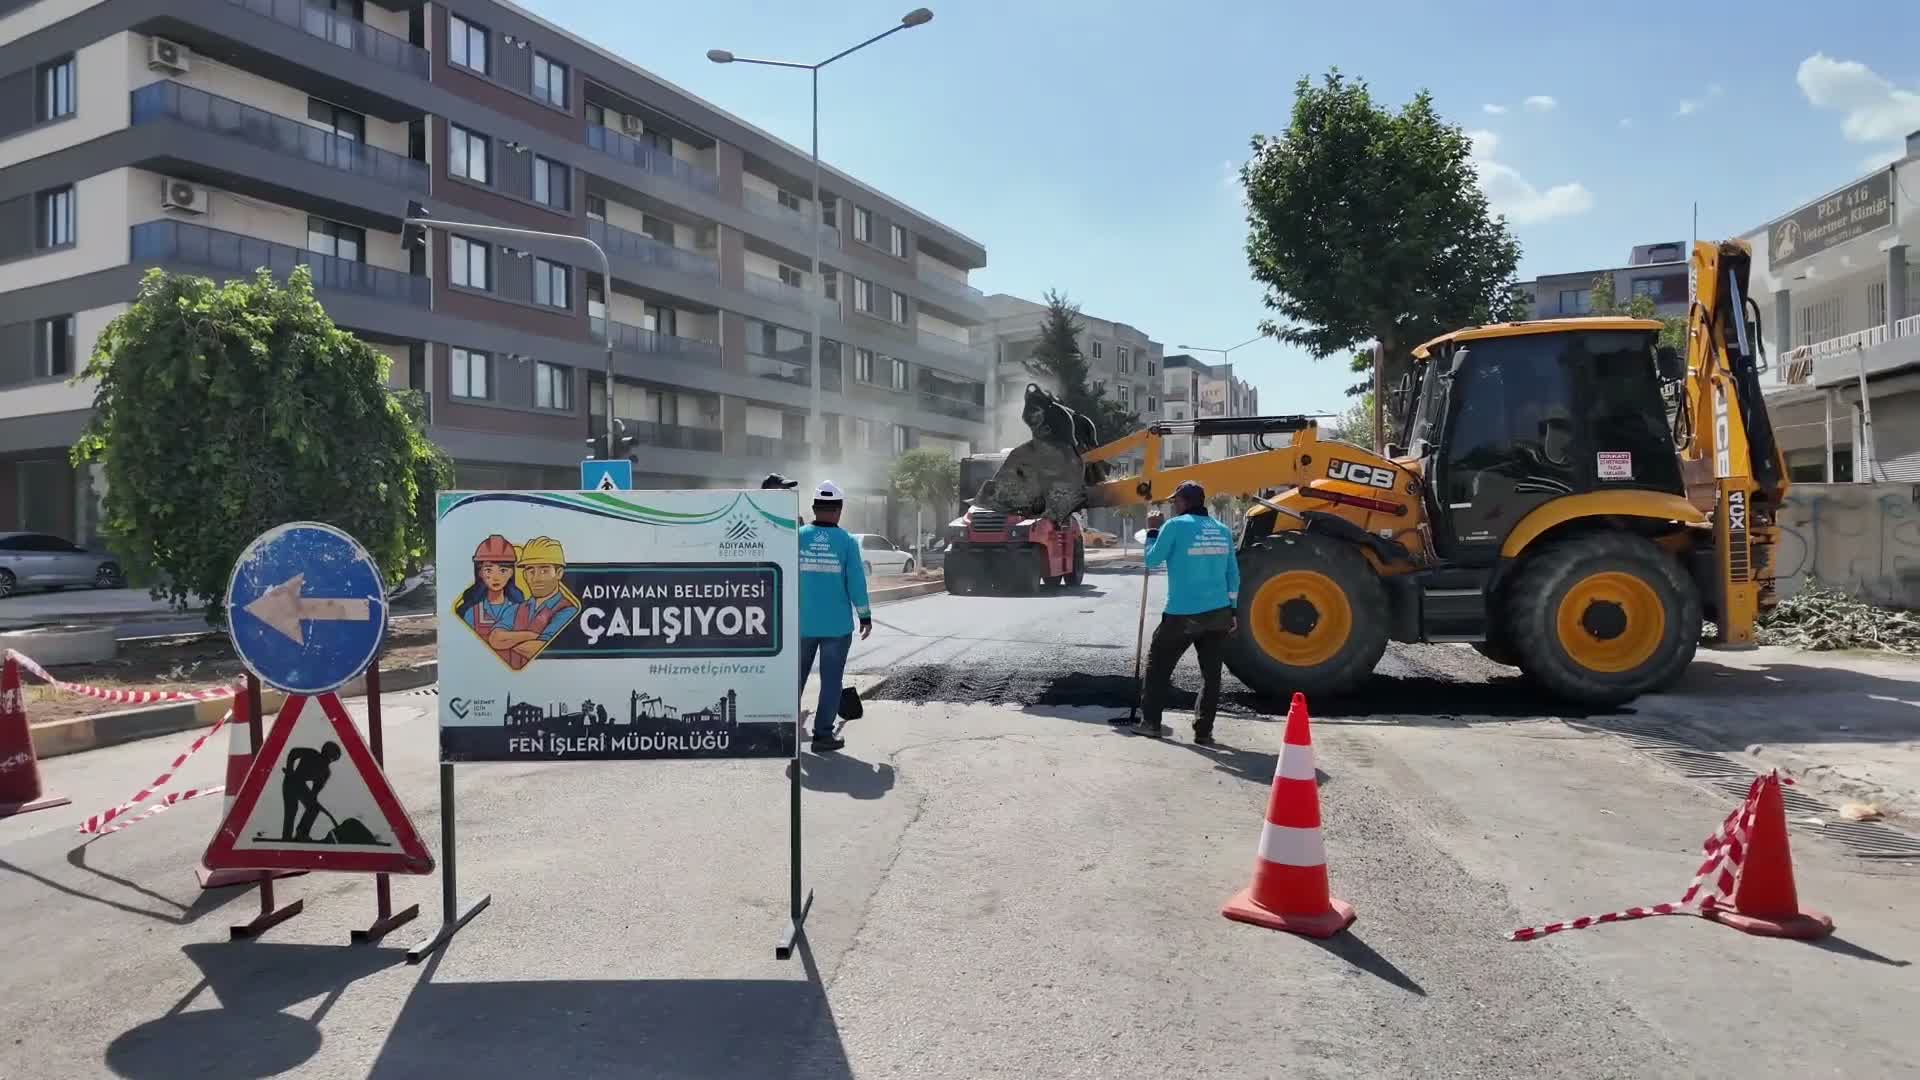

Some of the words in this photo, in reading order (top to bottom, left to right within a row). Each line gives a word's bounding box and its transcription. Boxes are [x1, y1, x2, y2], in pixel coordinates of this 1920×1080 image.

[1817, 197, 1842, 218] PET
[1850, 196, 1888, 222] Kliniği
[1328, 461, 1396, 489] JCB
[1729, 490, 1745, 530] 4CX
[582, 585, 669, 599] ADIYAMAN
[674, 580, 766, 598] BELEDİYESİ
[580, 606, 768, 645] ÇALIŞIYOR
[648, 661, 767, 675] #HizmetİçinVarız
[509, 738, 544, 754] FEN
[550, 735, 606, 754] İŞLERİ
[611, 732, 730, 752] MÜDÜRLÜĞÜ
